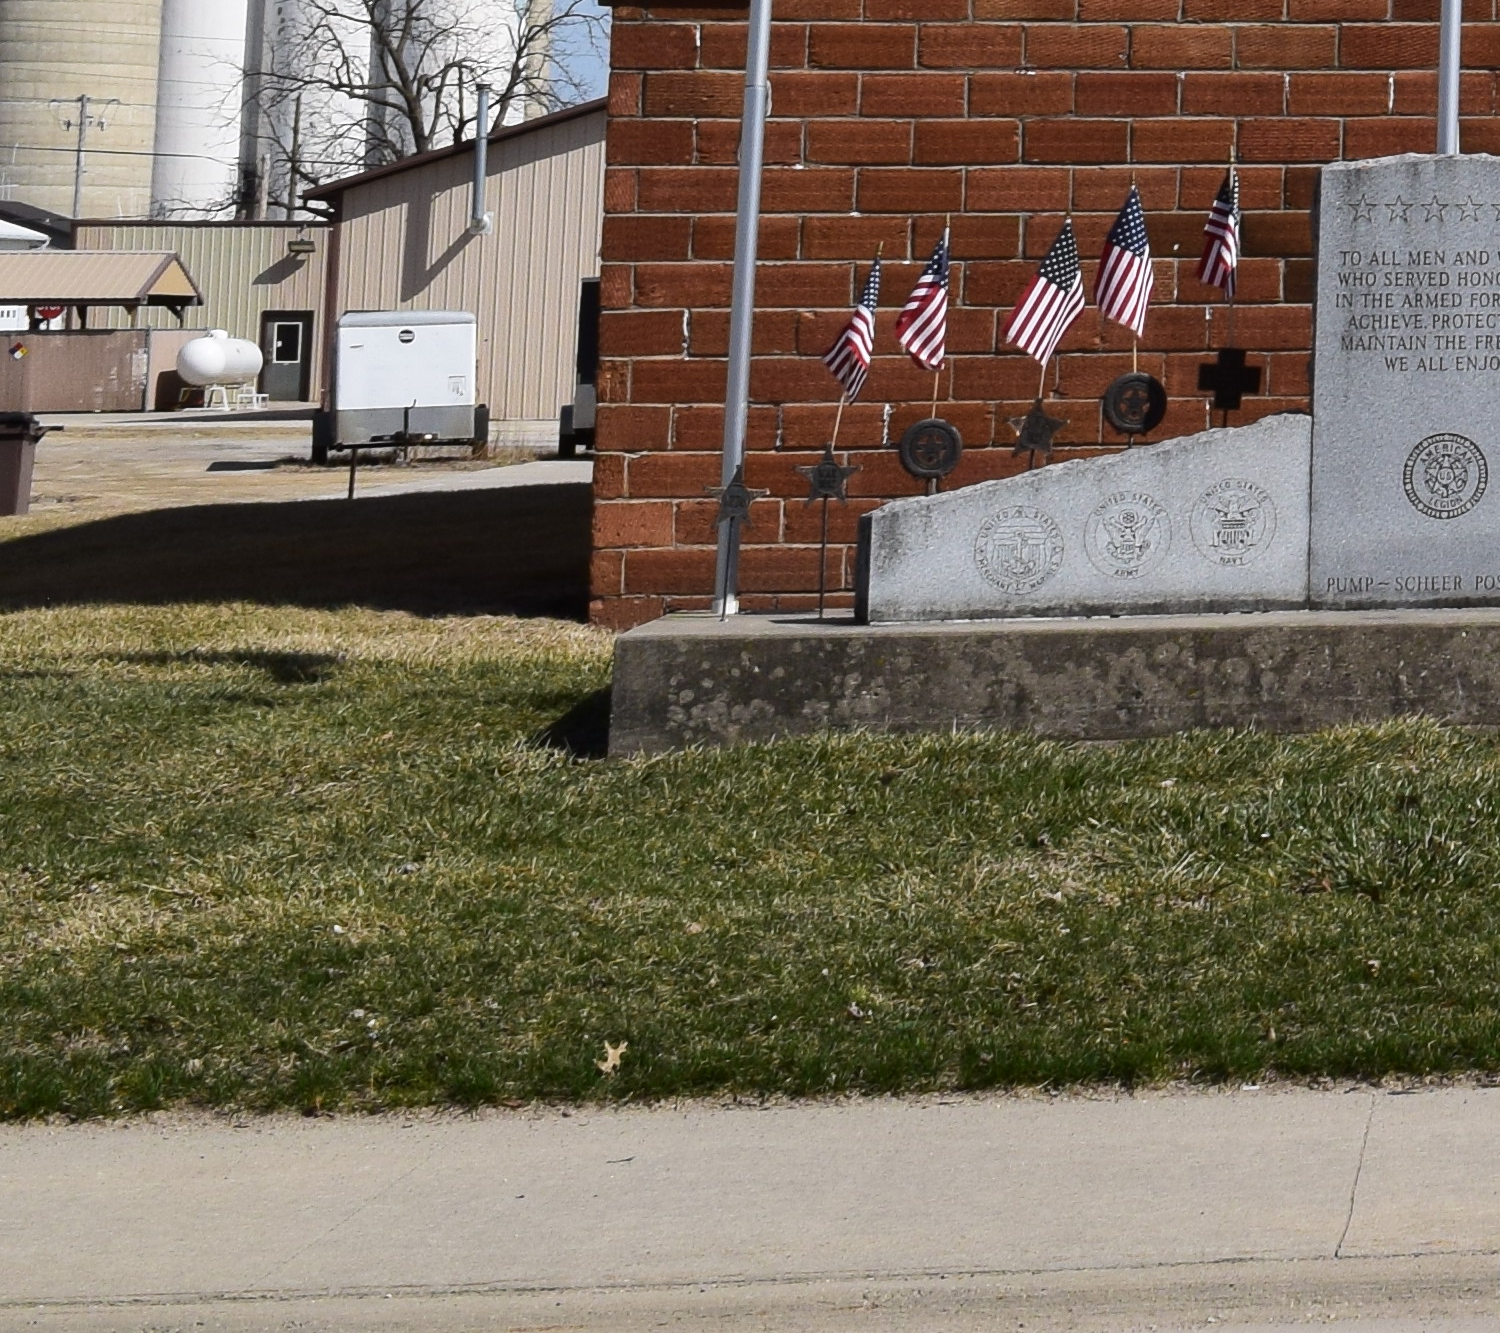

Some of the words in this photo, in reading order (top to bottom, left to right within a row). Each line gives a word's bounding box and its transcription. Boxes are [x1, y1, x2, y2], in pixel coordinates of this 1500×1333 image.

[1339, 250, 1363, 266] TO
[1368, 250, 1402, 266] ALL
[1406, 250, 1446, 266] MEN
[1452, 250, 1491, 266] AND
[1337, 271, 1377, 287] WHO
[1383, 271, 1451, 287] SERVED
[1335, 293, 1354, 309] IN
[1360, 293, 1395, 309] THE
[1401, 293, 1463, 309] ARMED
[1340, 335, 1428, 351] MAINTAIN
[1433, 335, 1468, 351] THE
[1384, 356, 1409, 372] WE
[1415, 356, 1450, 372] ALL
